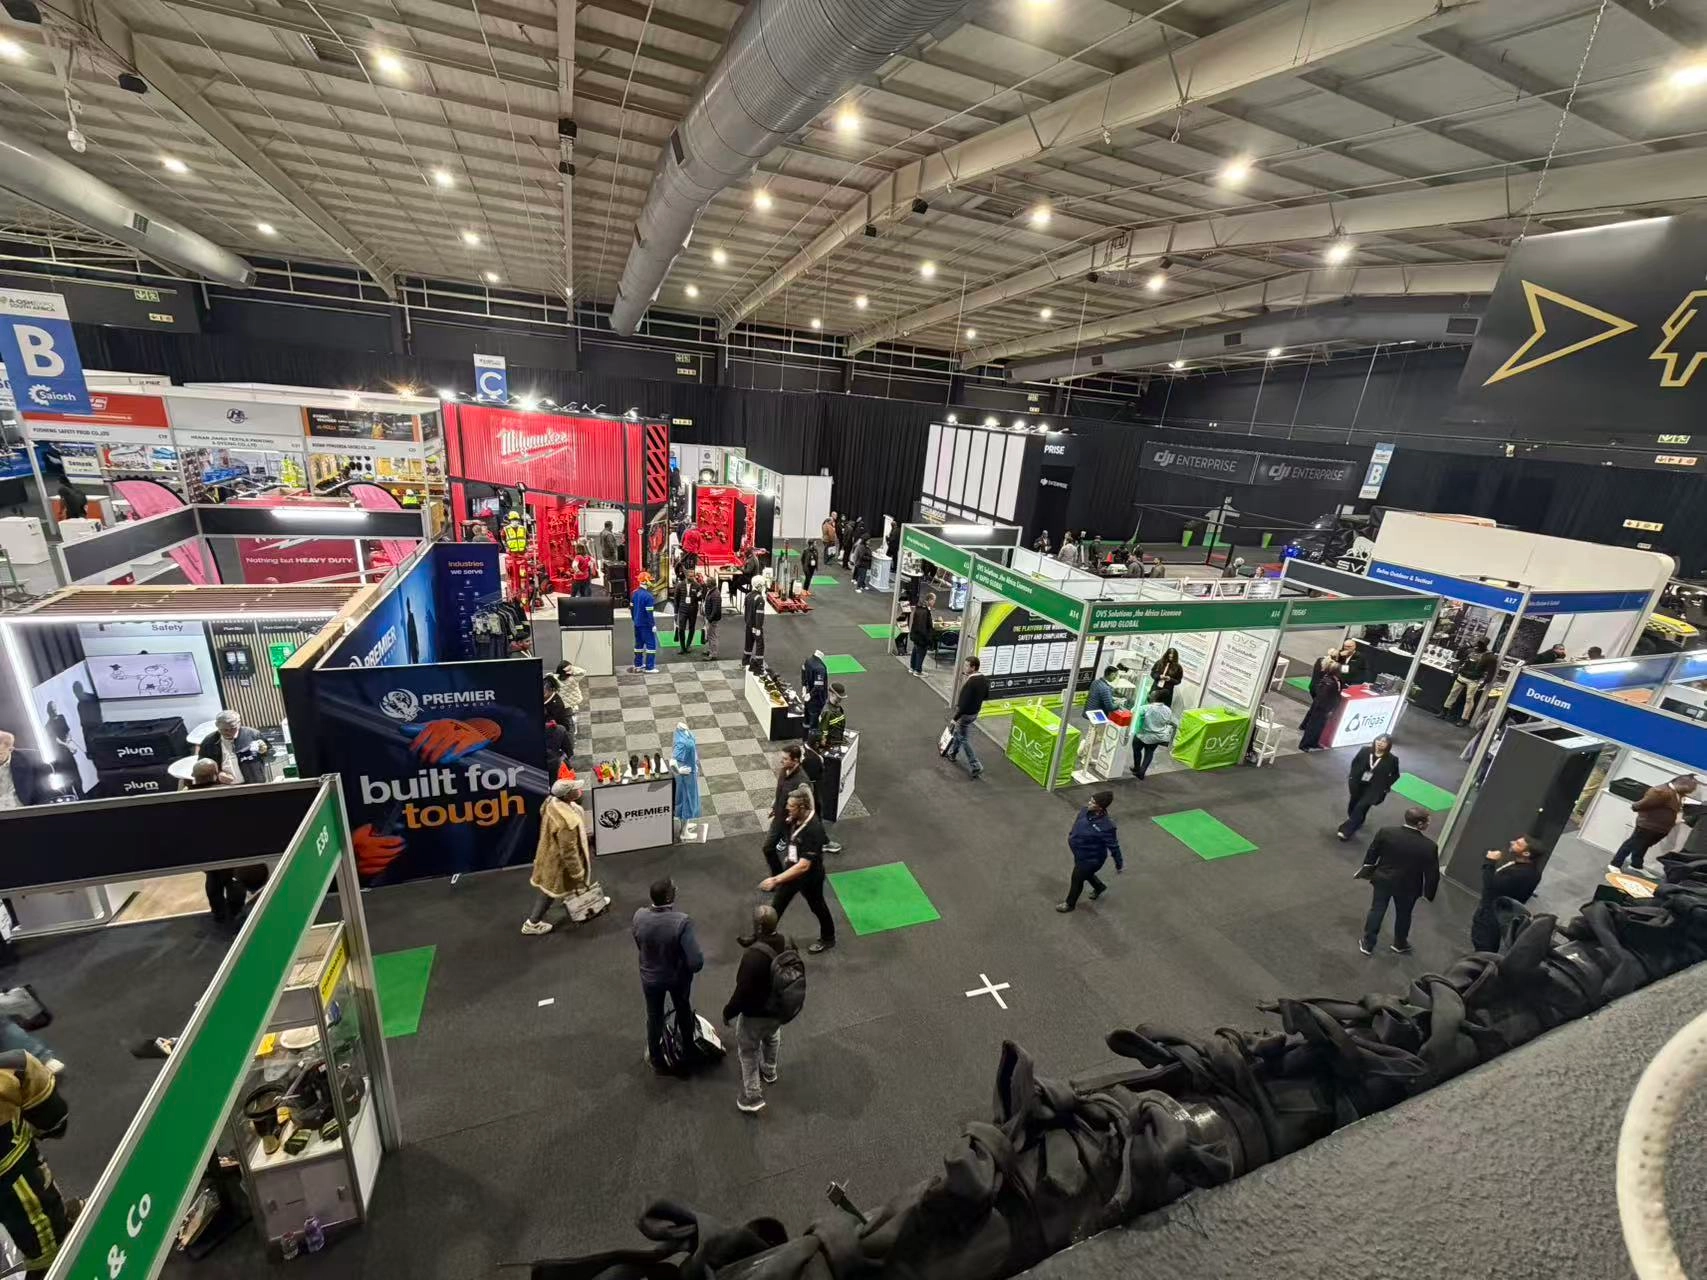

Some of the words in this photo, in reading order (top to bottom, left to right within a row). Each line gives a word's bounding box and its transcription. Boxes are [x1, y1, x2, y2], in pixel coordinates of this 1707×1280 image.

[13, 324, 64, 377] B
[480, 372, 503, 396] C
[40, 392, 76, 401] Saiosh
[496, 428, 568, 457] Milwaukee
[1044, 445, 1066, 455] PRISE
[1176, 454, 1238, 472] ENTERPRISE
[1291, 466, 1344, 480] ENTERPRISE
[1368, 464, 1383, 484] B
[1390, 571, 1409, 580] Outdoor
[1415, 576, 1433, 585] Tactical
[1108, 609, 1132, 617] Solutions
[151, 623, 183, 632] Safety
[364, 625, 397, 667] PREMIER
[1232, 634, 1257, 648] OVS
[422, 690, 495, 705] PREMIER
[1526, 688, 1571, 710] Doculam
[1361, 715, 1385, 728] Trigas
[1012, 726, 1044, 759] OVS
[1205, 734, 1239, 750] OVS
[117, 746, 154, 758] plum
[124, 780, 158, 792] plum
[359, 768, 458, 805] built
[464, 764, 525, 792] for
[402, 790, 526, 829] tough
[624, 806, 670, 818] PREMIER
[316, 825, 328, 856] E38
[107, 1244, 127, 1279] &
[126, 1193, 151, 1238] Co
